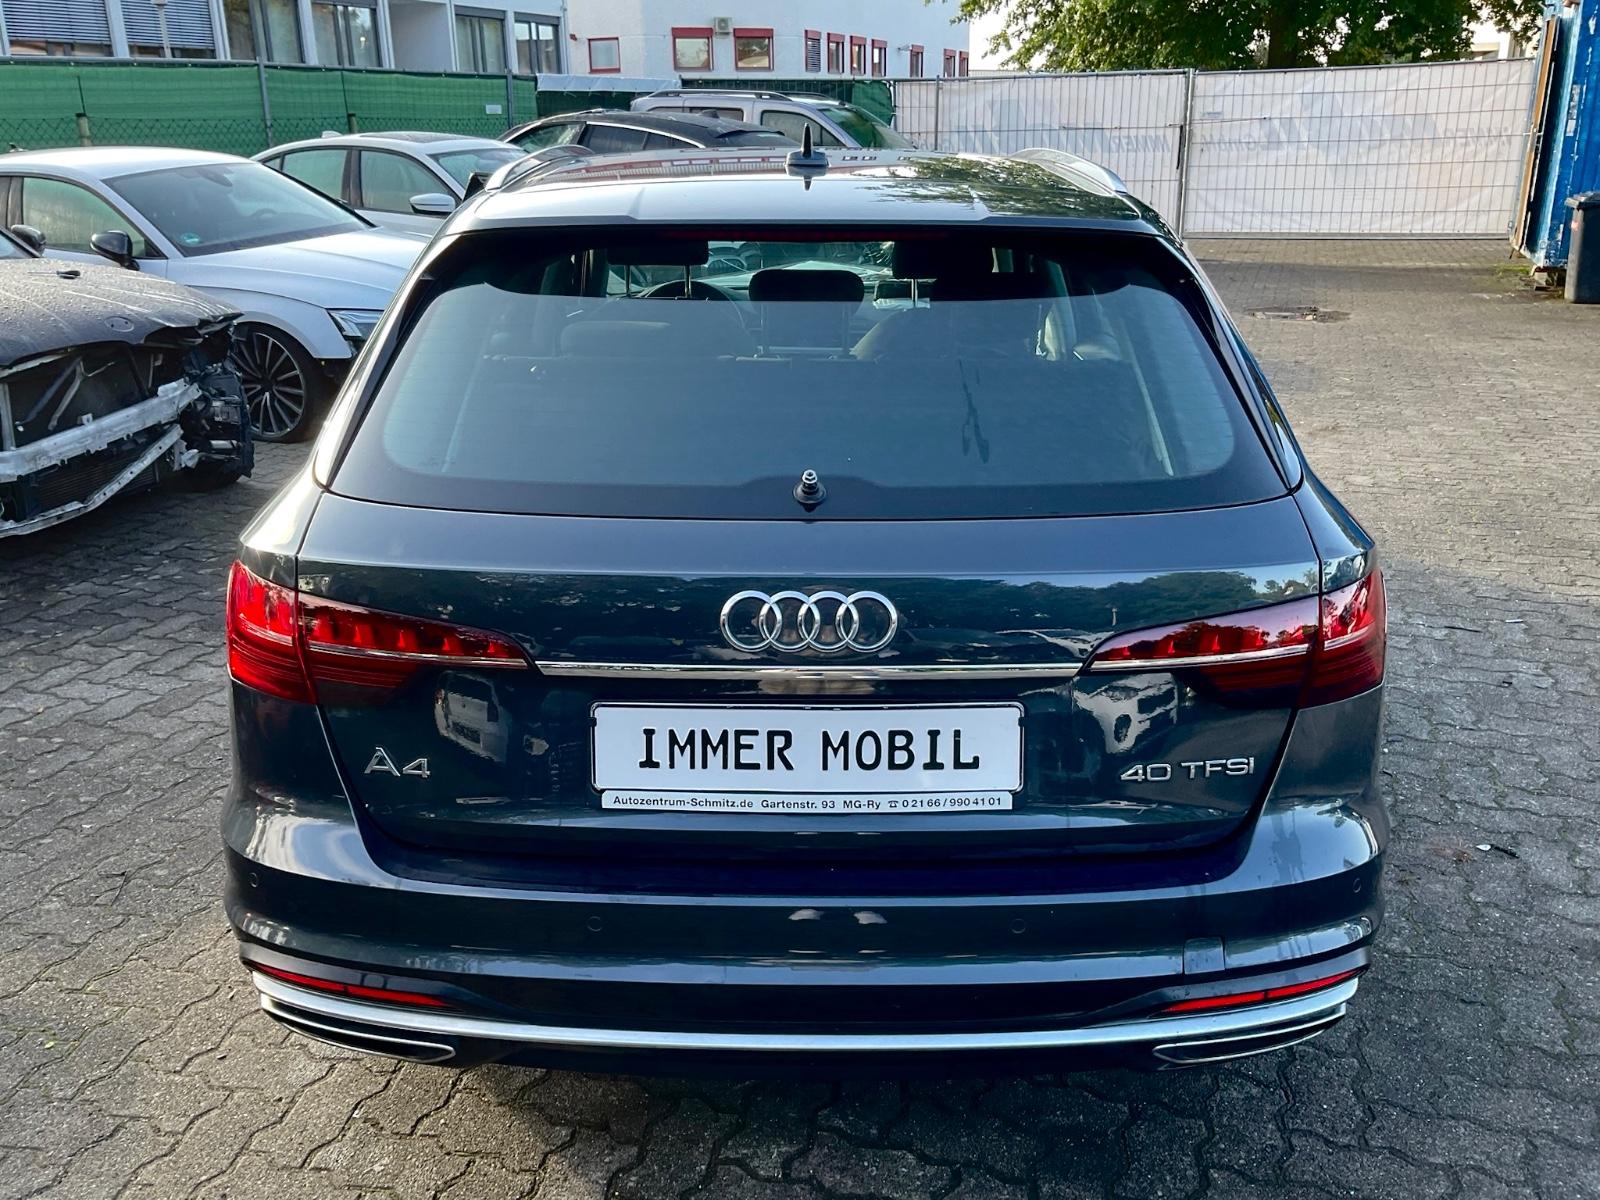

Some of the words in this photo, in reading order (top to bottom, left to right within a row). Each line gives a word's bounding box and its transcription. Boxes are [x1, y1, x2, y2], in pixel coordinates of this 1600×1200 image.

[364, 746, 431, 778] A4
[638, 728, 795, 771] IMMER
[821, 729, 980, 771] MOBIL
[1120, 763, 1172, 782] 40
[1180, 756, 1255, 779] TFSI
[612, 795, 754, 809] Autozentrum-Schmitz.de
[760, 799, 818, 809] Gartenstr.
[821, 800, 836, 809] 93
[842, 799, 881, 810] MG-Ry
